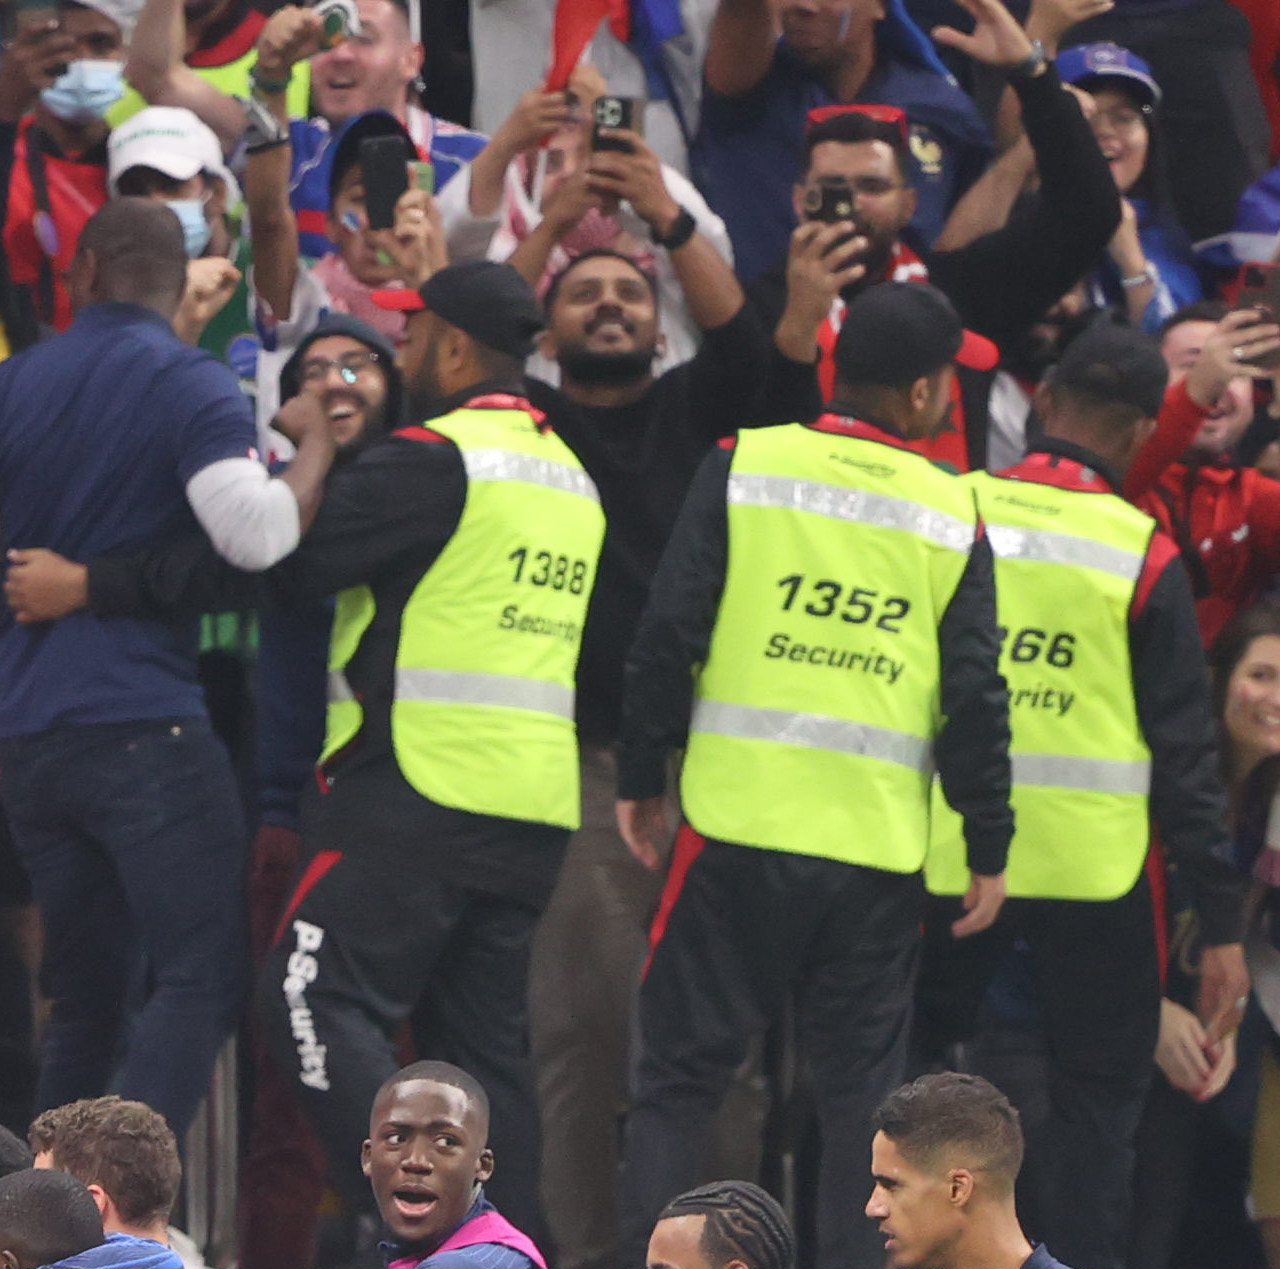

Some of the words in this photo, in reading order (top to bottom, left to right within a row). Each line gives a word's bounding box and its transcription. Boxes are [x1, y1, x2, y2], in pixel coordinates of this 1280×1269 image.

[508, 546, 587, 596] 1388
[777, 572, 912, 634] 1352
[764, 632, 905, 685] Security
[997, 625, 1076, 669] 66
[1007, 683, 1075, 716] rity
